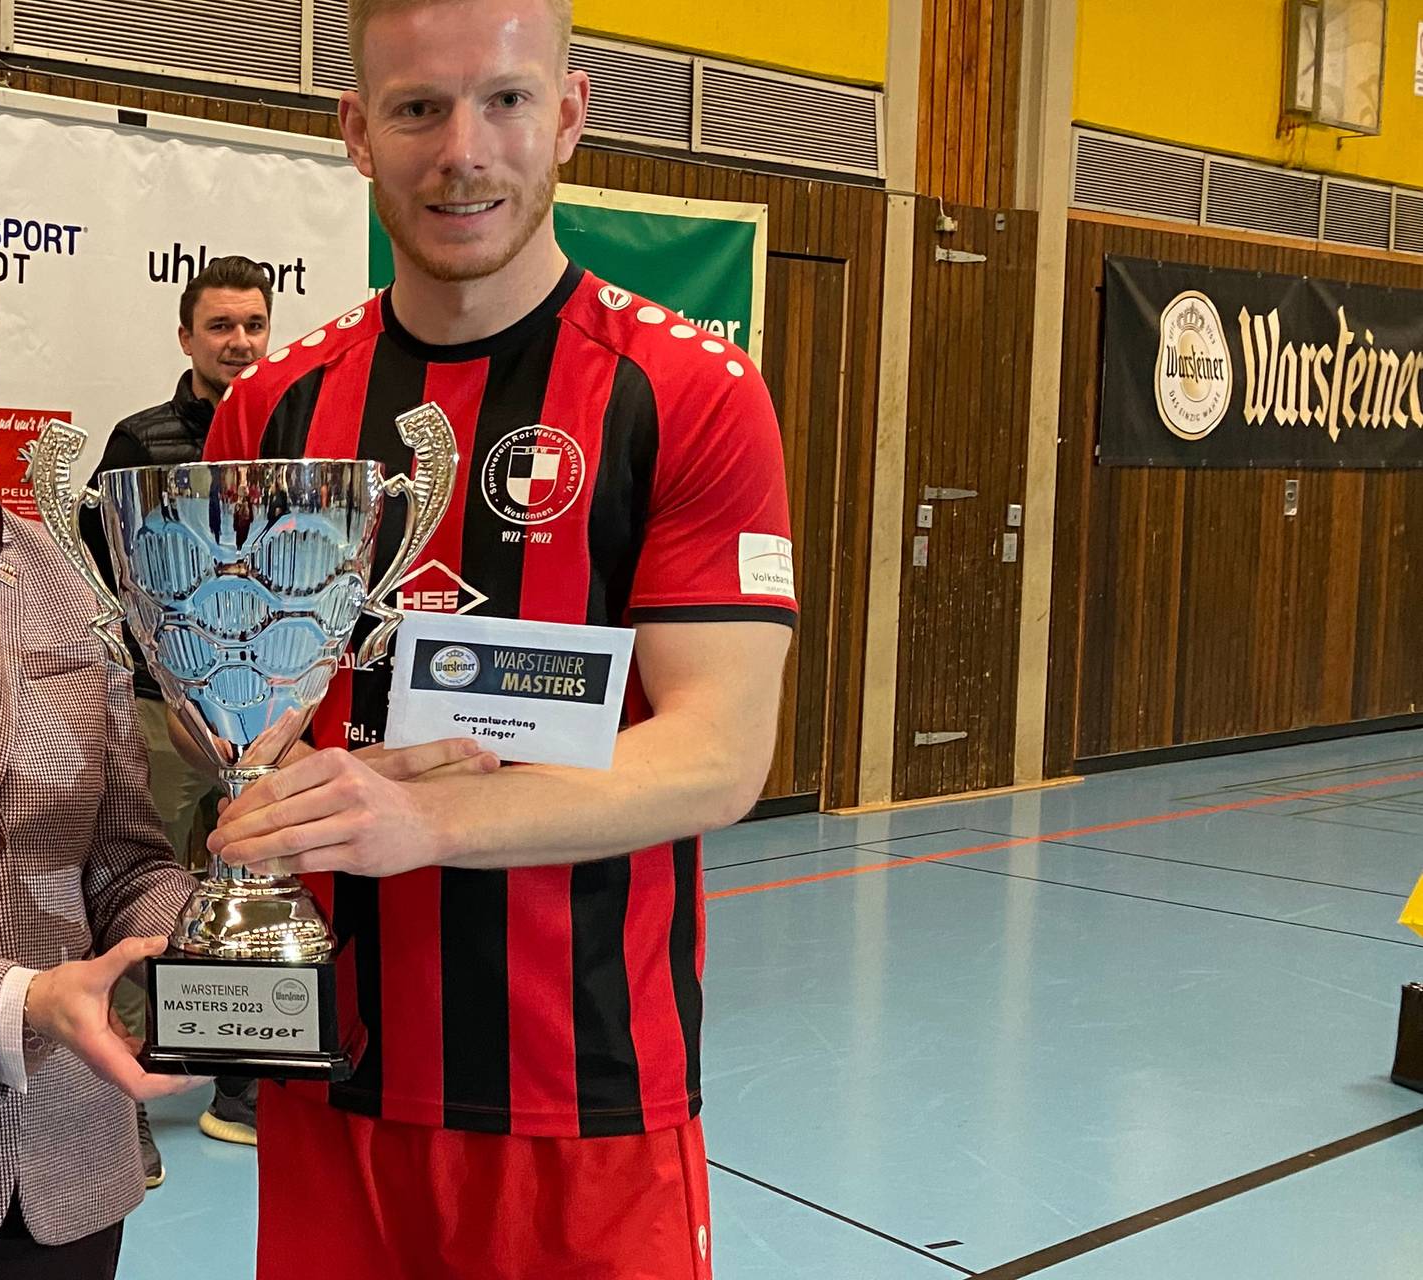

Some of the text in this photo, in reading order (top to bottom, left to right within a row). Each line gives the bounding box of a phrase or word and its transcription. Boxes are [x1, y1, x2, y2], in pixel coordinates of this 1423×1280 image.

[148, 242, 305, 295] uhlort
[1166, 344, 1224, 383] Warsteiner
[489, 440, 512, 495] Sportverein
[504, 505, 553, 520] Westönnen
[501, 531, 521, 543] 1922
[530, 532, 552, 544] 2022
[396, 591, 459, 610] HSS
[435, 661, 475, 672] Warsteiner
[494, 650, 585, 675] WARSTEINER
[501, 672, 586, 697] MASTERS
[453, 714, 536, 731] Gesamtwertung
[343, 722, 376, 742] Tel.:
[181, 984, 249, 996] WARSTEINER
[164, 1001, 263, 1013] MASTERS 2023
[177, 1022, 304, 1039] 3. Sieger
